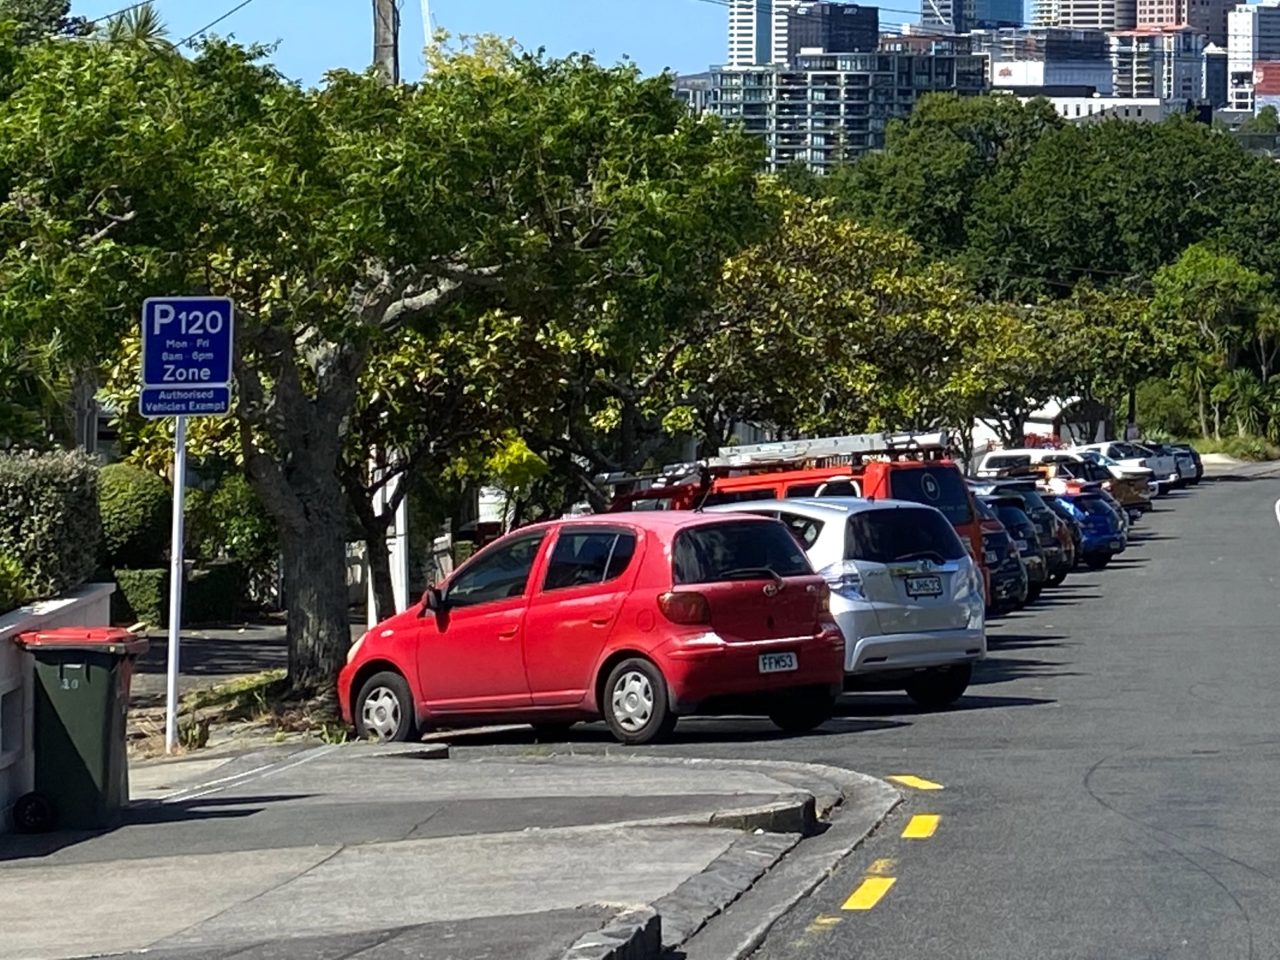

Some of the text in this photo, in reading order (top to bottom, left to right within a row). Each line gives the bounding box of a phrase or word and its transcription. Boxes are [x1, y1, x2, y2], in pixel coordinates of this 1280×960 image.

[166, 339, 188, 349] Mon
[196, 338, 210, 348] Fri
[162, 352, 183, 361] 8am
[192, 351, 214, 362] 6pm
[162, 364, 211, 381] Zone
[158, 390, 214, 400] Authorised
[145, 401, 225, 411] Vehicles Exempt
